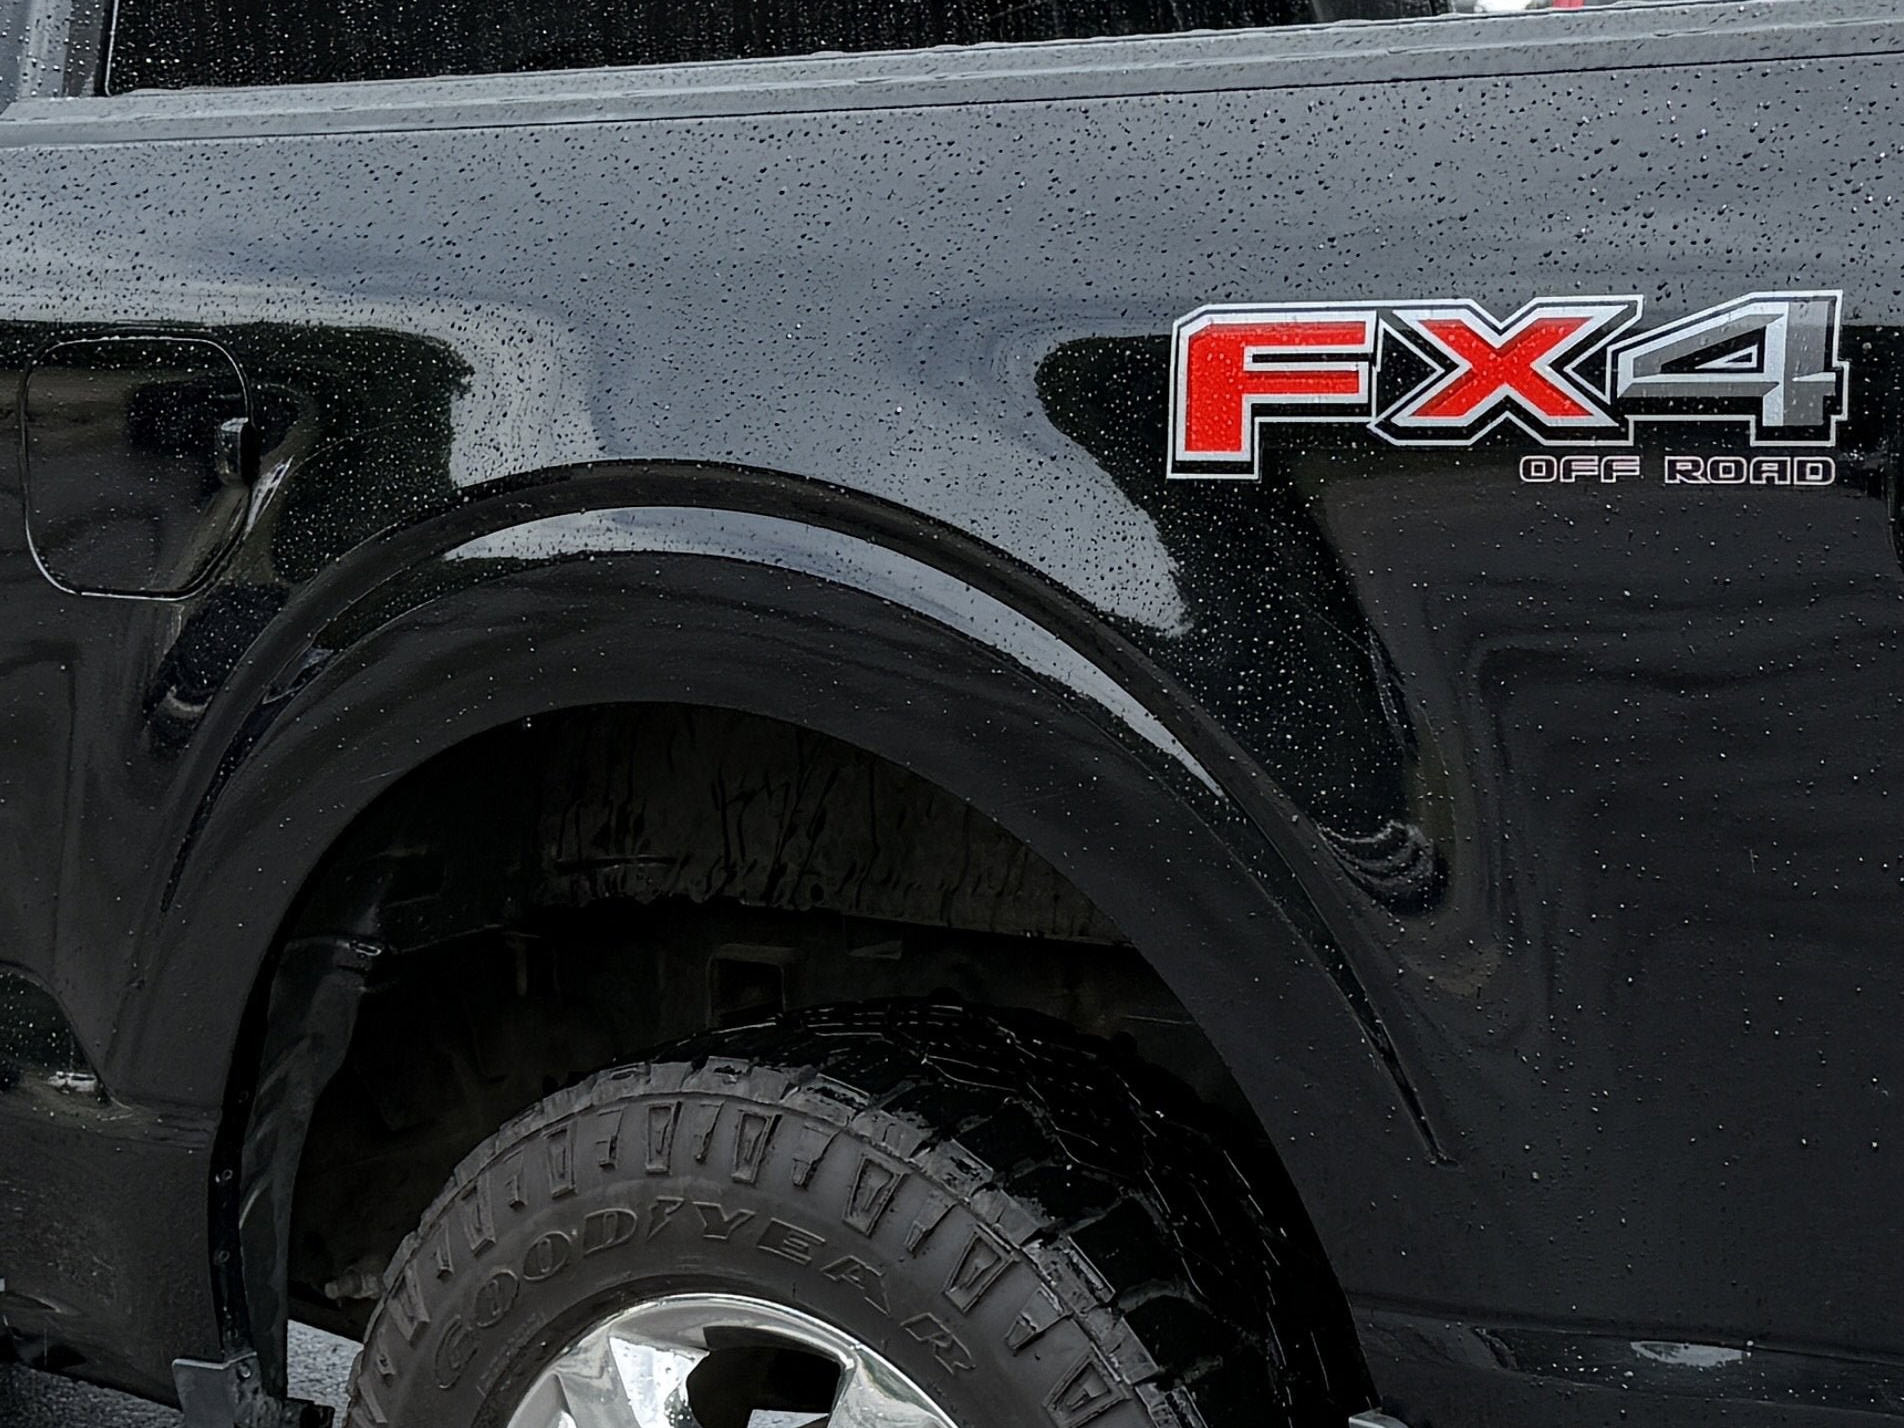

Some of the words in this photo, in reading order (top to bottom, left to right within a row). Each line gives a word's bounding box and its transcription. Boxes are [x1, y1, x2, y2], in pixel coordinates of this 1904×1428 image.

[1167, 289, 1850, 479] FX4
[1519, 455, 1642, 485] OFF
[1665, 455, 1837, 486] ROAD
[433, 1195, 977, 1391] GOODYEAR
